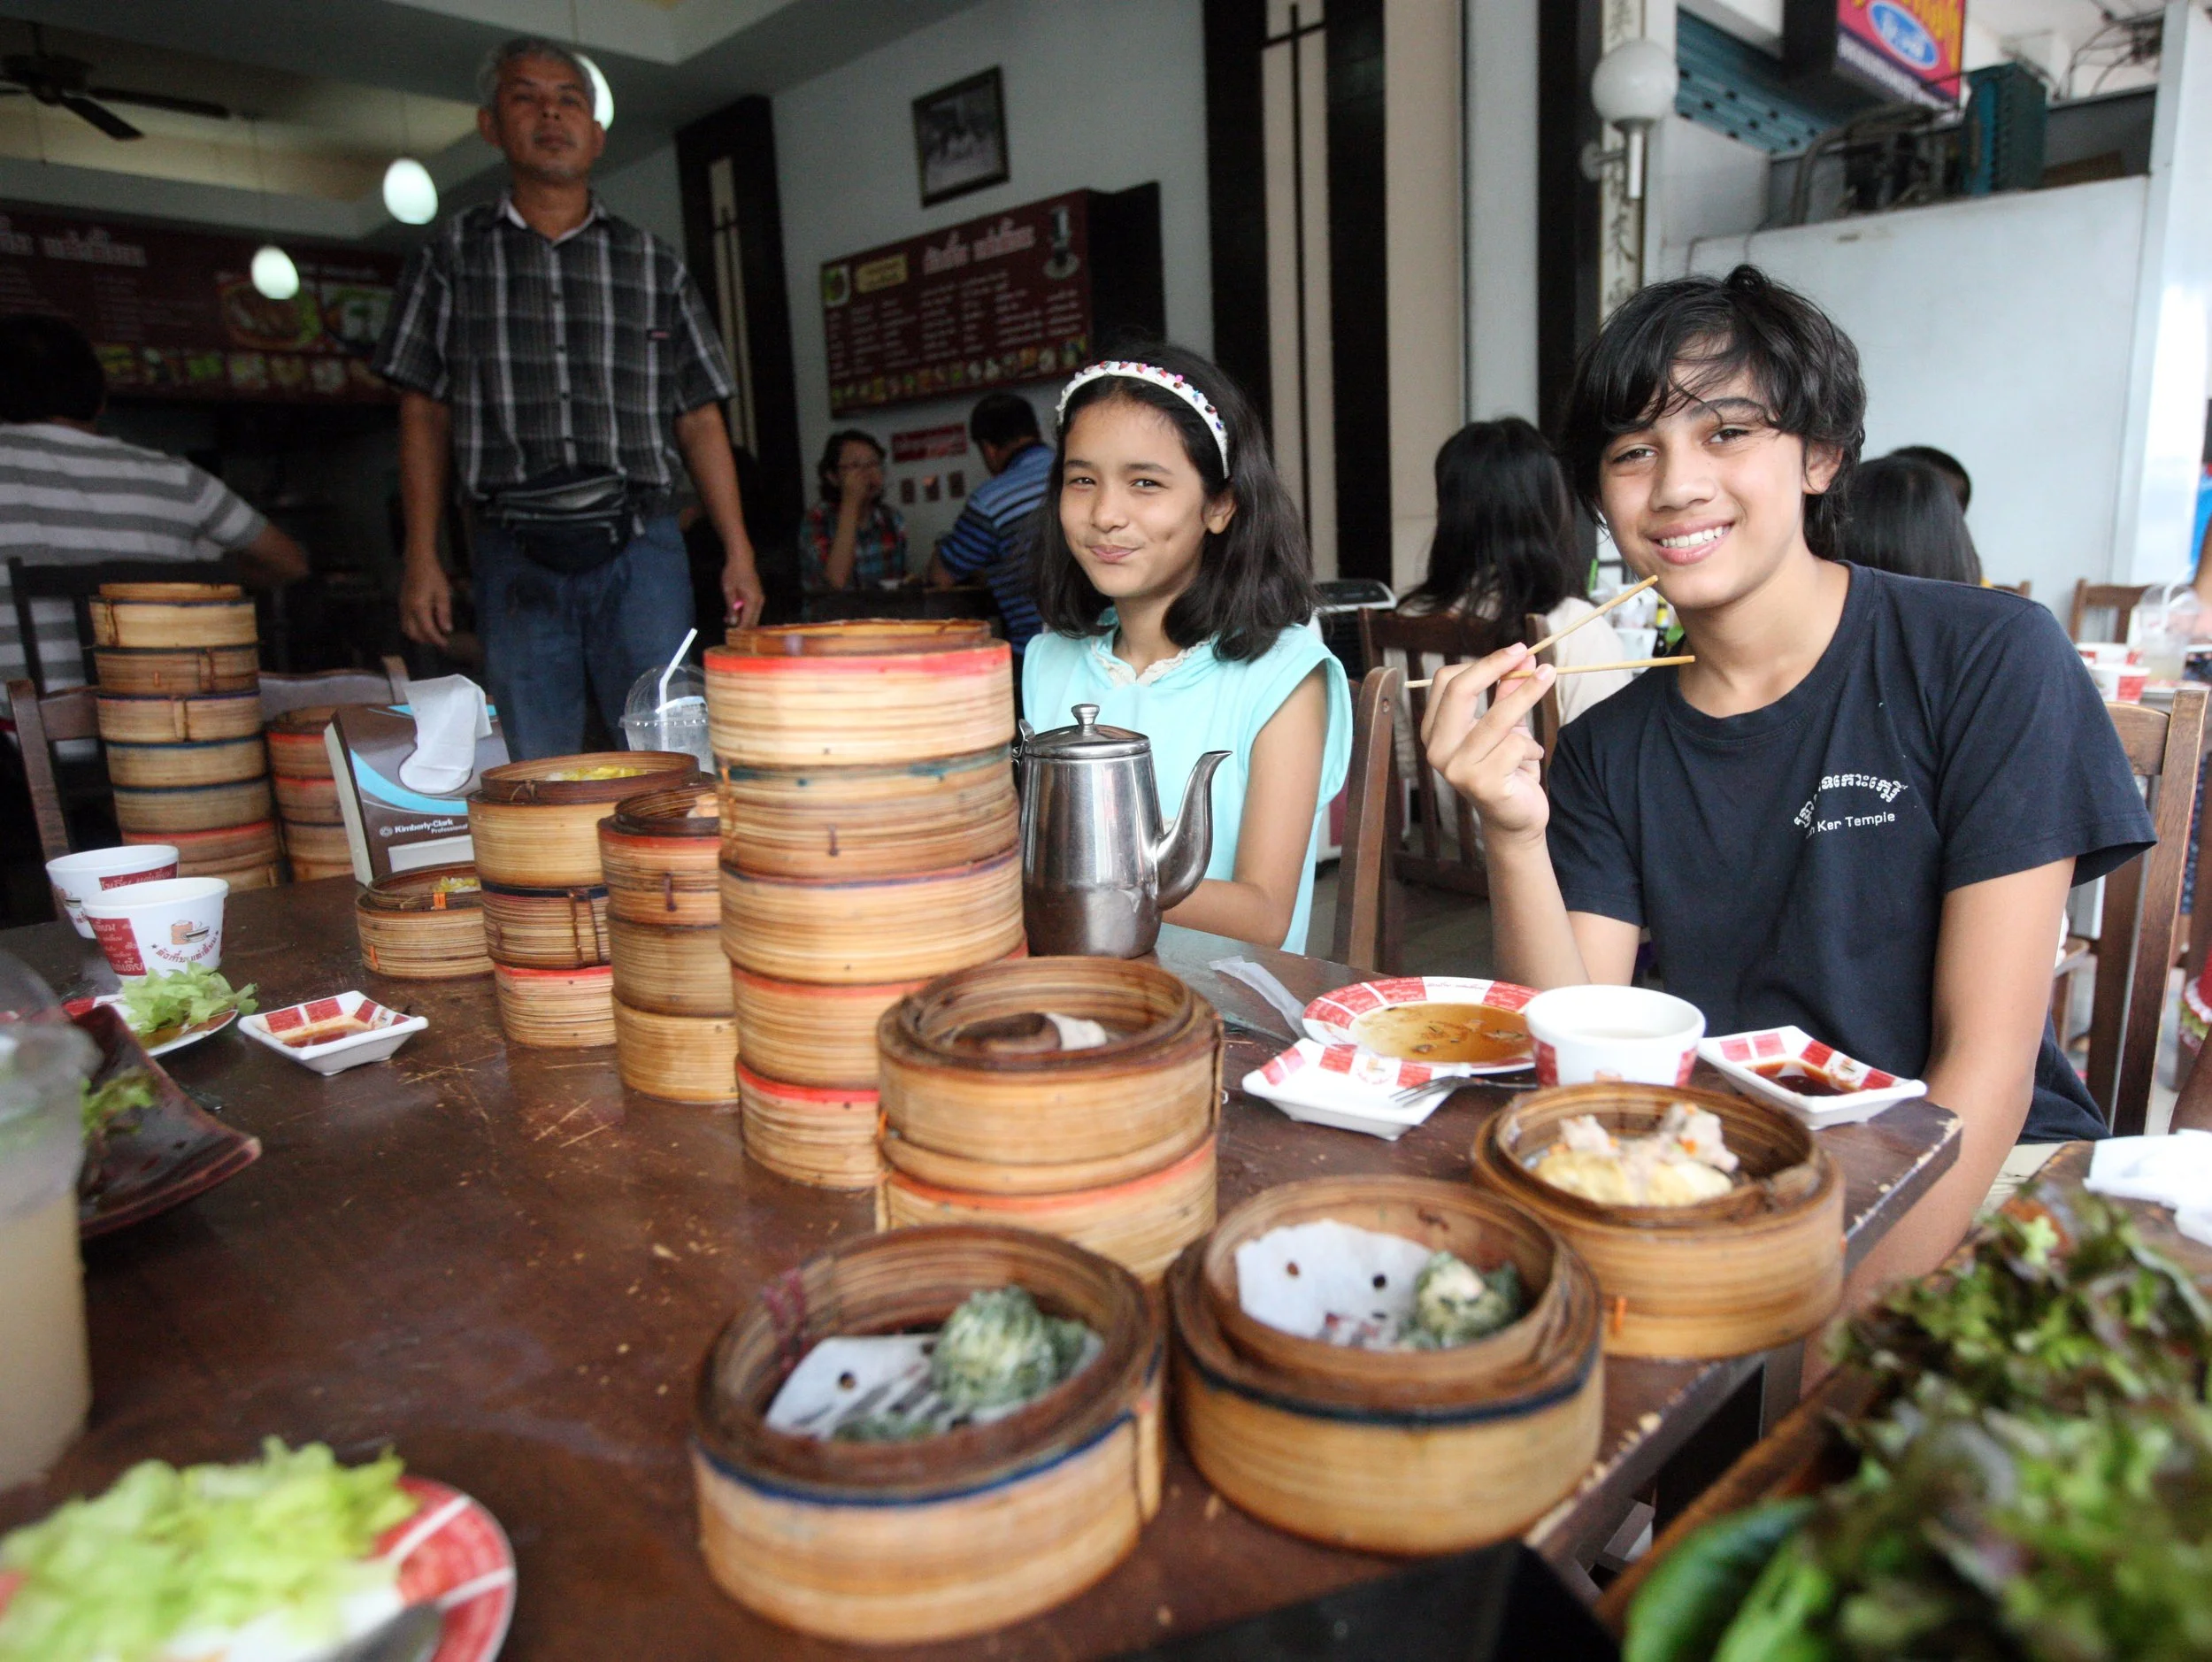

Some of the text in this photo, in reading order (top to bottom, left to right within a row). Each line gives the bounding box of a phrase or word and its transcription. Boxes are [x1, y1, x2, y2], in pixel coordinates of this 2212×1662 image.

[395, 818, 454, 834] Kimberly-Clark
[431, 823, 468, 835] Professional
[1817, 812, 1895, 832] Ker Temple
